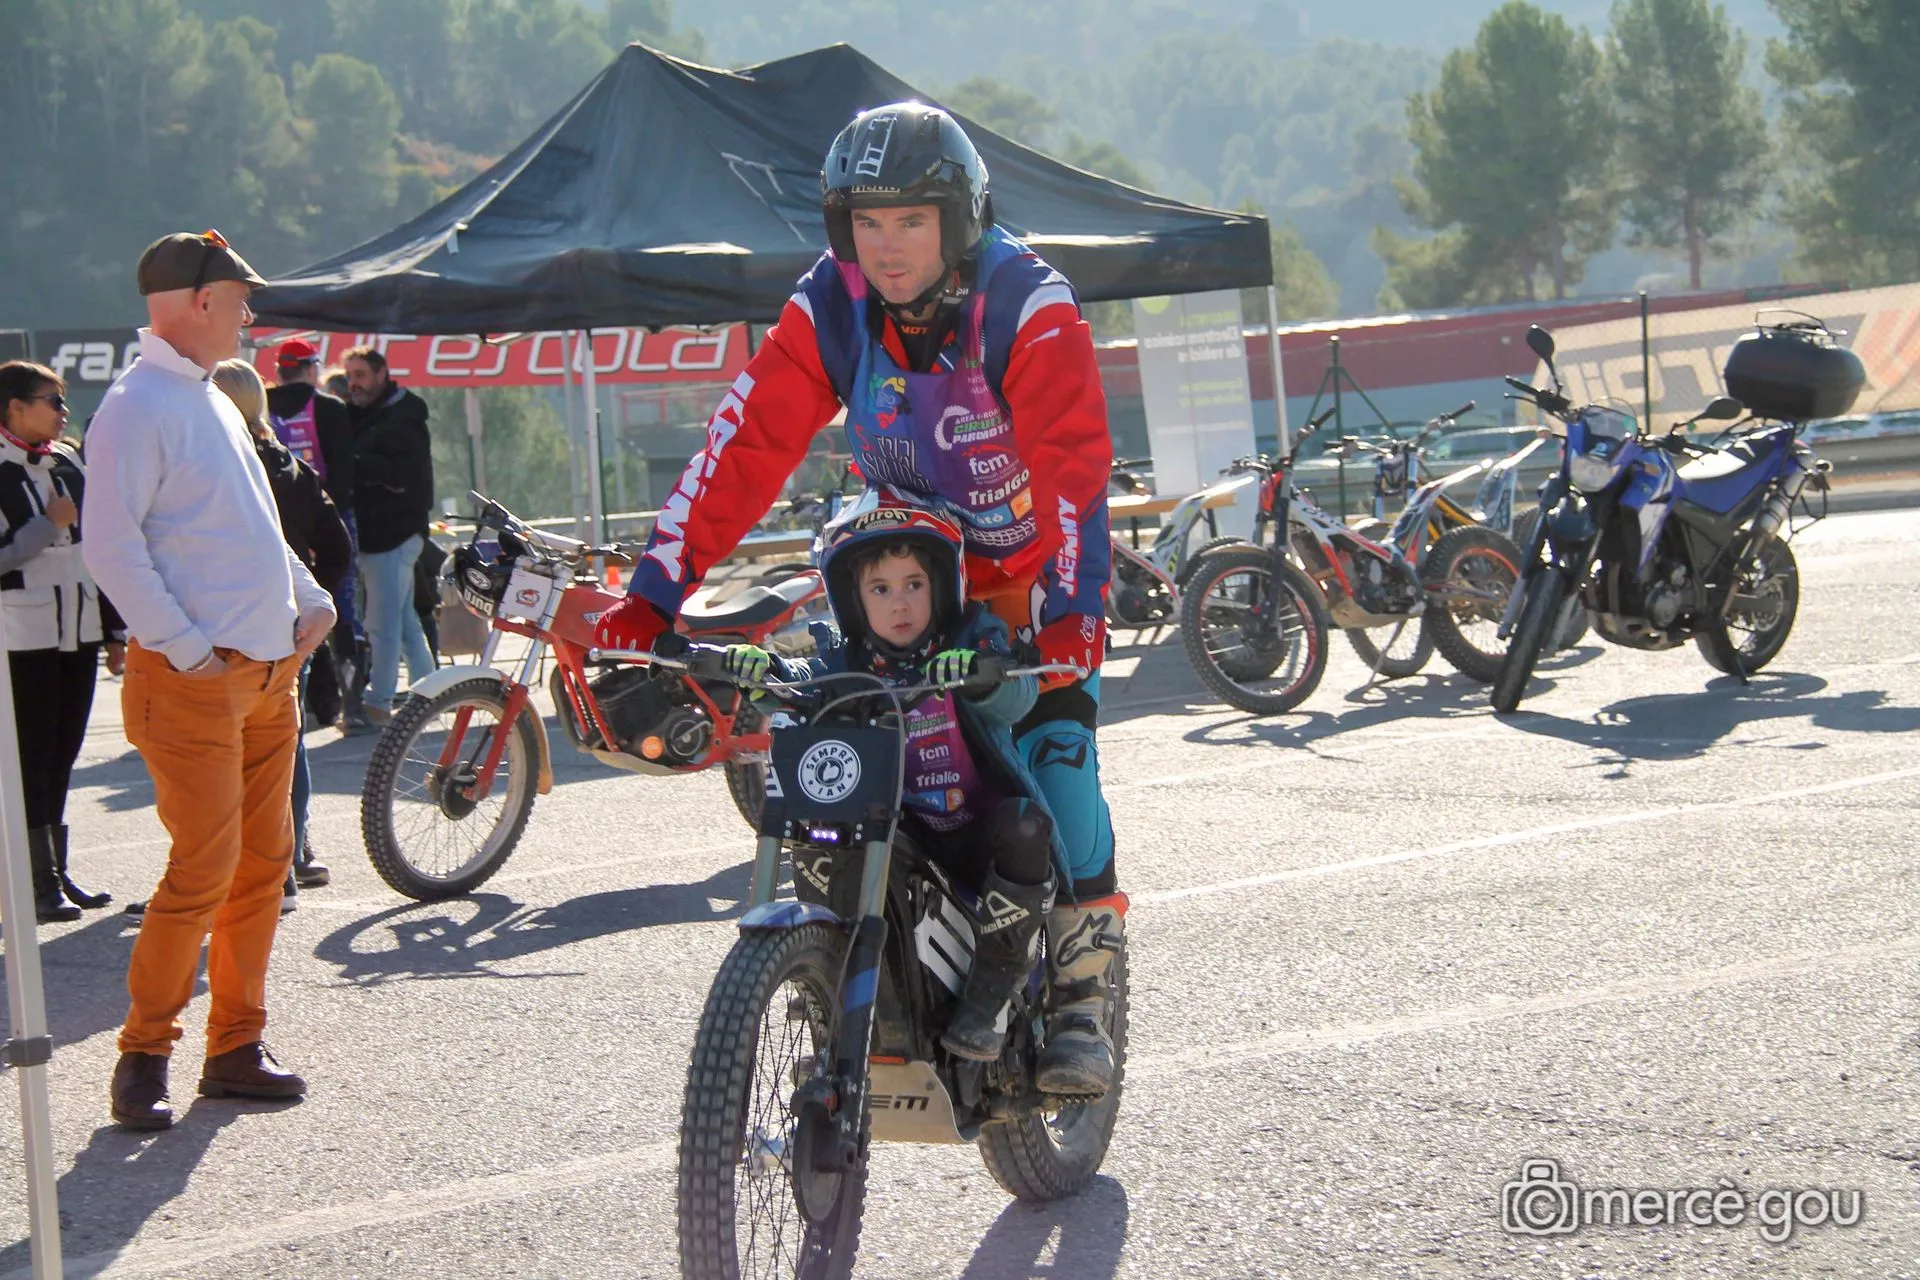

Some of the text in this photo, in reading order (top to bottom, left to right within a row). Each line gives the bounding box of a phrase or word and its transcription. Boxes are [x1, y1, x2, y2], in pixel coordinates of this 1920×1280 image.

[968, 468, 1030, 506] TrialGo
[806, 747, 854, 770] SEMPRE
[919, 745, 949, 762] fcm
[818, 783, 846, 797] IAN
